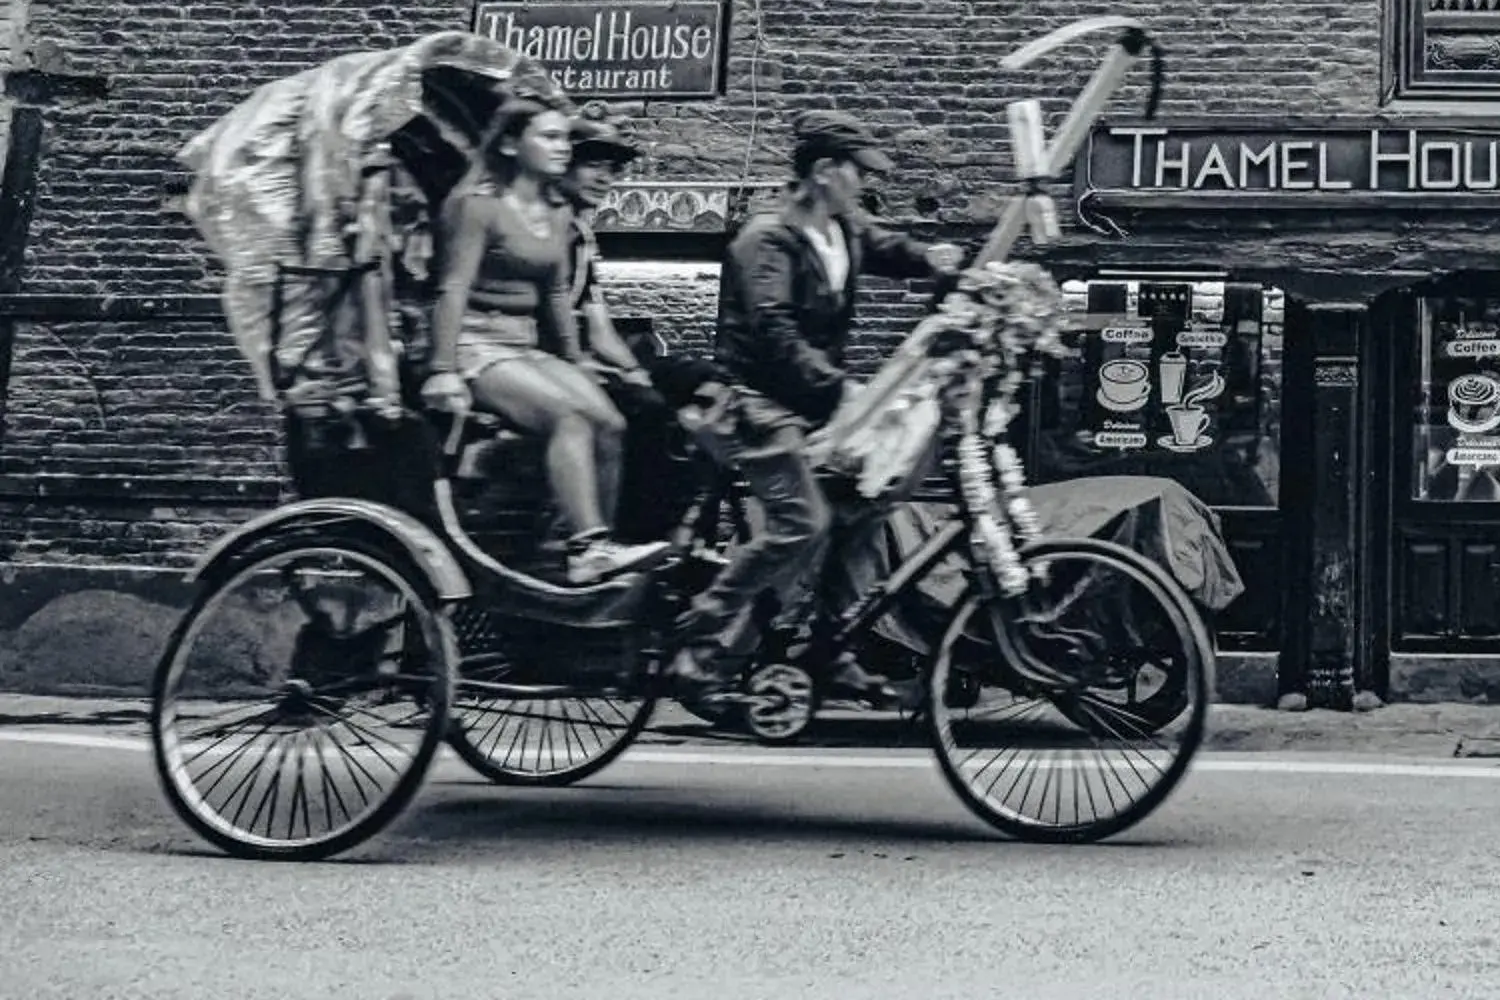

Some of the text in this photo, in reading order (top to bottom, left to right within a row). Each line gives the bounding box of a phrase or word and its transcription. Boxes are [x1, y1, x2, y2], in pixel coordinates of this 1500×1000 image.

[485, 11, 711, 61] Thamel House
[551, 64, 673, 89] staurant
[1110, 128, 1352, 189] THAMEL
[1453, 342, 1497, 353] Coffee
